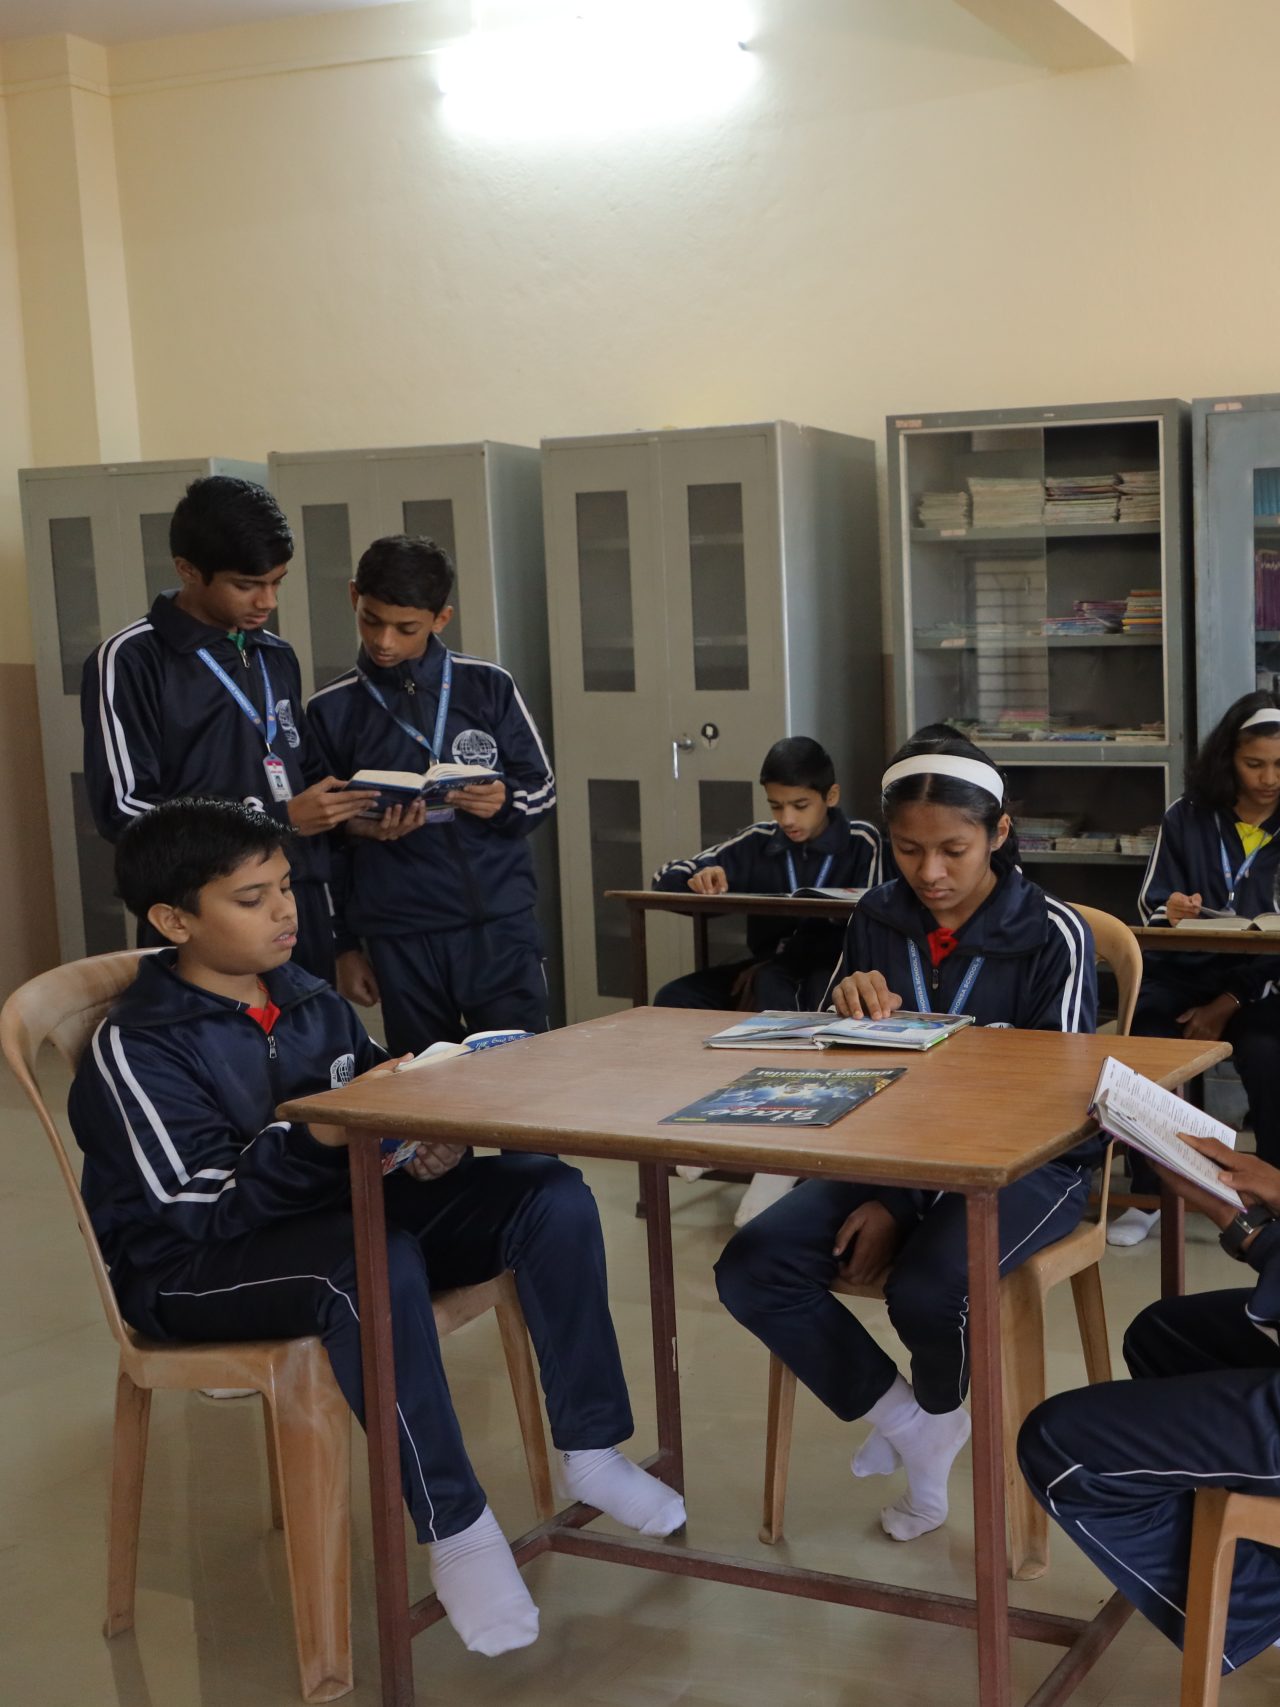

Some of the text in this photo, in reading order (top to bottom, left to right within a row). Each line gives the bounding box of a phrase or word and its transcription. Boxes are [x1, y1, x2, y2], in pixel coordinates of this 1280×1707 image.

[911, 956, 921, 985] SCHOOL
[916, 985, 928, 1013] PHONSA
[951, 988, 967, 1015] PHONSA
[963, 962, 979, 988] SCHOOL
[756, 1069, 831, 1078] Potential
